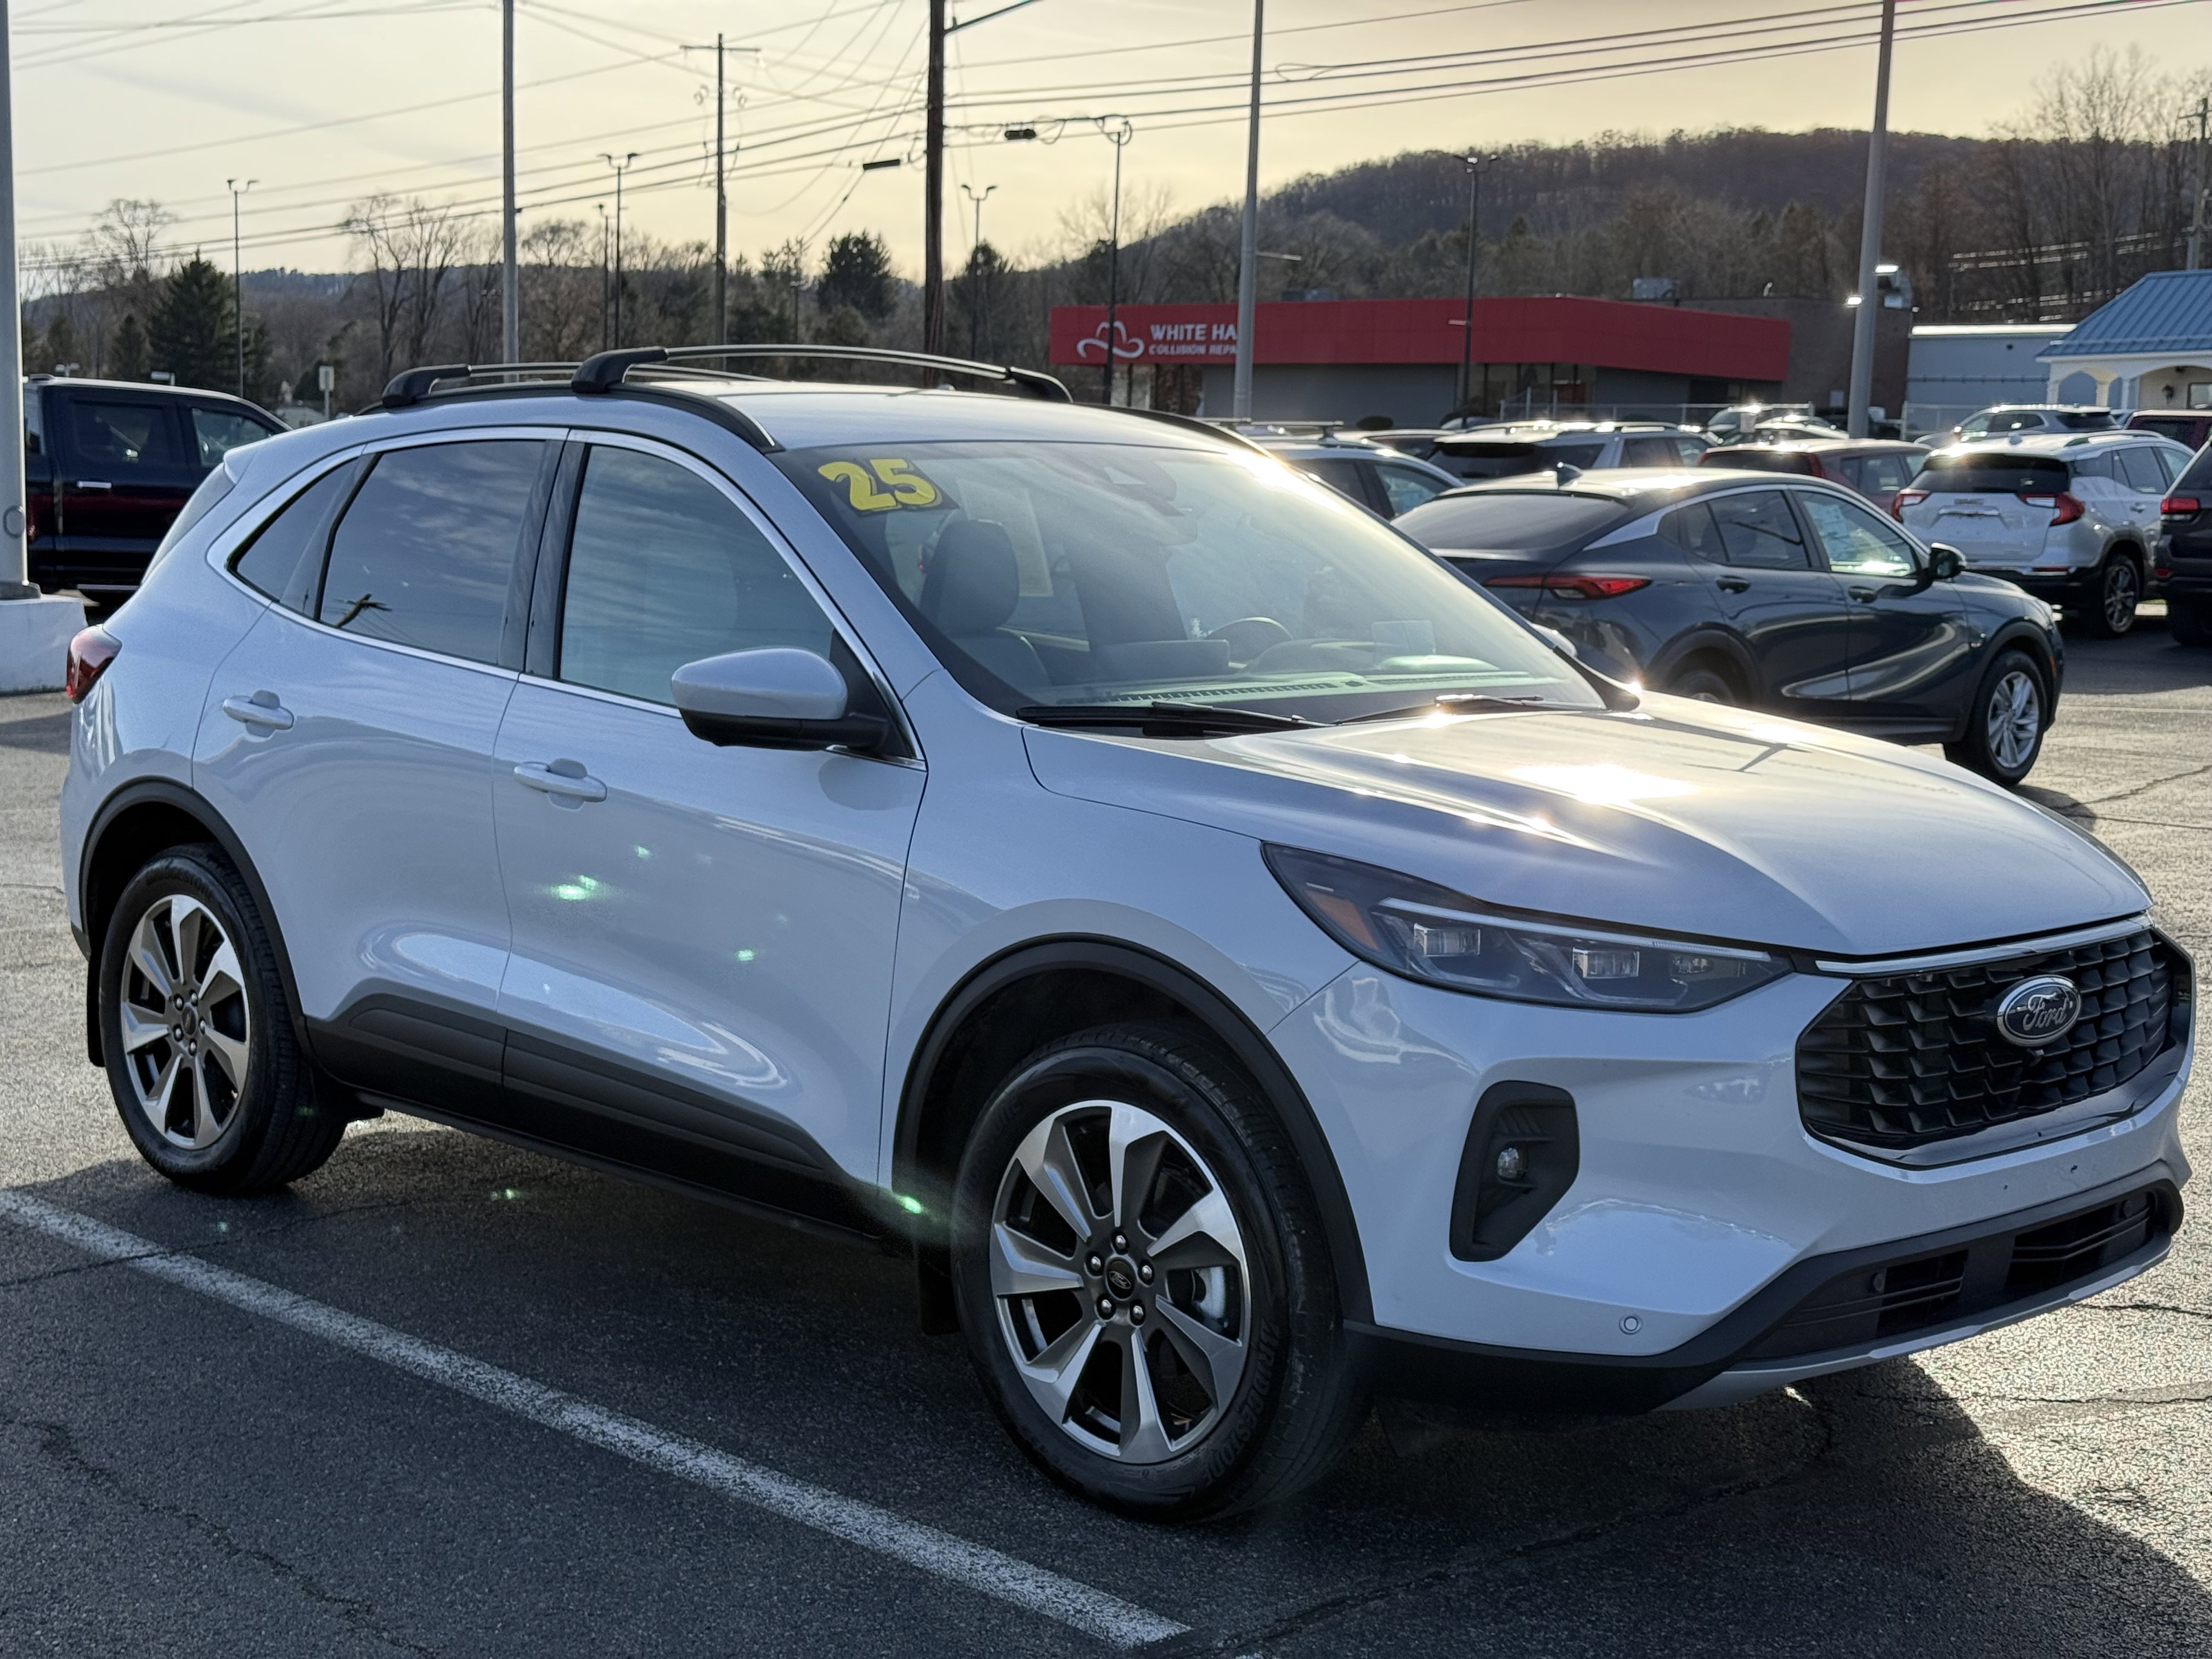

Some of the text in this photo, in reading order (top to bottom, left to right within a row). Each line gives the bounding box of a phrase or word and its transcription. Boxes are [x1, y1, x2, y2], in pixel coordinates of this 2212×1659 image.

[1149, 344, 1237, 355] COLLISION REPA
[1150, 324, 1238, 341] WHITE HA
[818, 458, 943, 511] 25
[2023, 992, 2069, 1031] Ford
[1202, 1318, 1280, 1487] BRIDGESTONE
